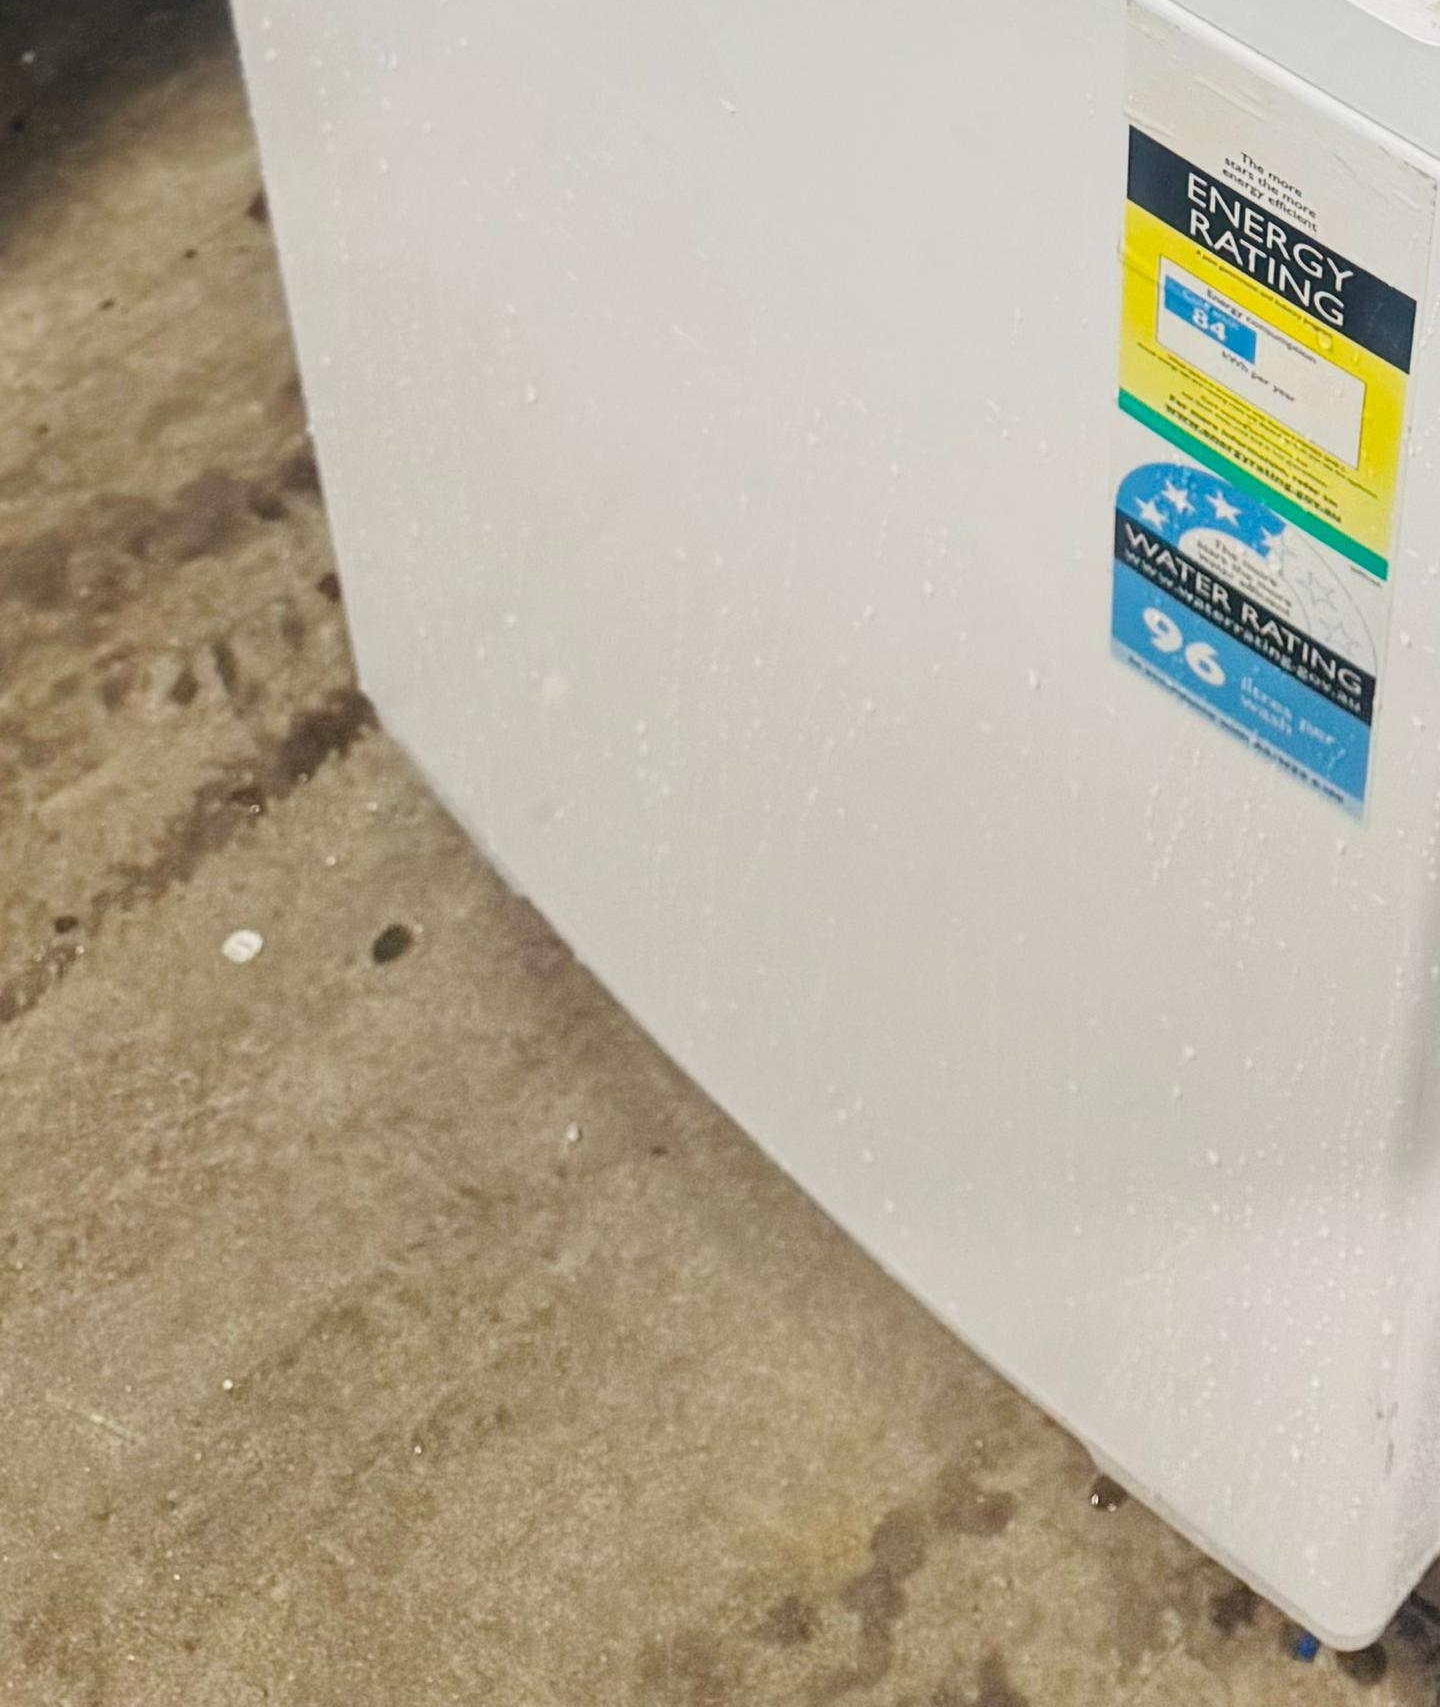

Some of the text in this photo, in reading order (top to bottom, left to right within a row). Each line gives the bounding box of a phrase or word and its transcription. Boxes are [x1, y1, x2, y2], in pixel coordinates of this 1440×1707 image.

[1222, 169, 1317, 233] energy efficient
[1225, 157, 1316, 218] stars the more
[1240, 151, 1302, 197] The more
[1187, 172, 1354, 292] ENERGY
[1189, 208, 1346, 327] RATING
[1192, 307, 1227, 341] 84
[1207, 289, 1243, 318] Energy
[1222, 350, 1295, 402] kWh per year
[1166, 403, 1341, 523] www.energyrating.gov.au
[1123, 548, 1361, 712] www.waterrating.gov.au
[1125, 523, 1362, 699] WATER RATING
[1143, 606, 1226, 687] 96
